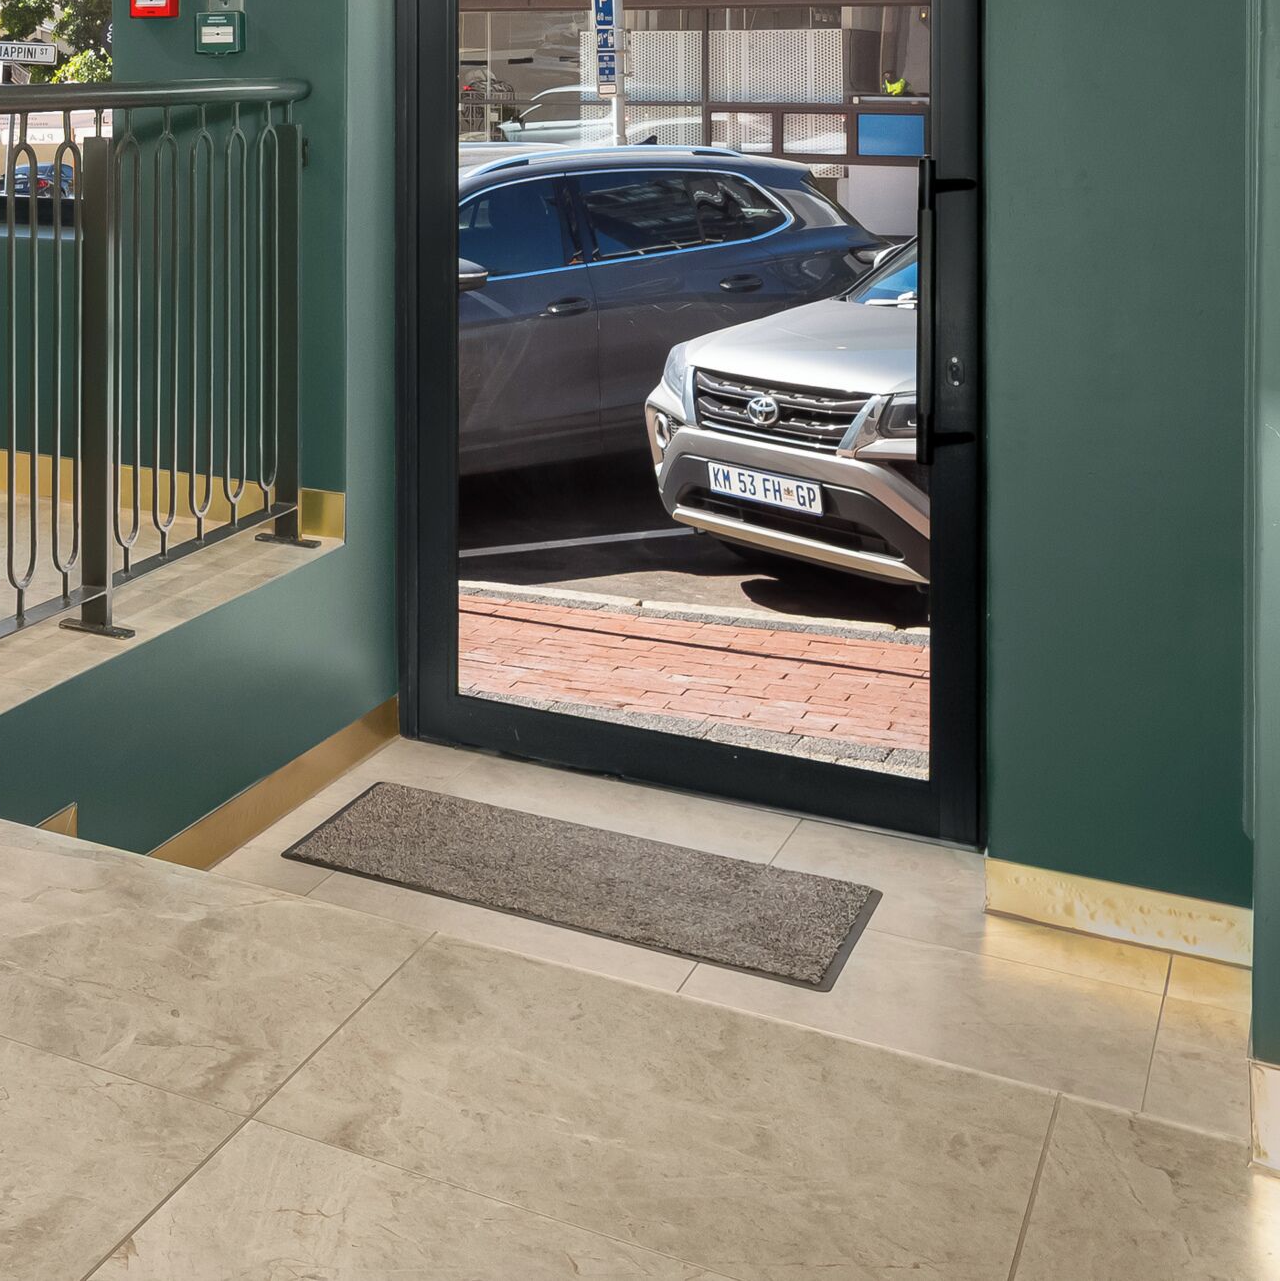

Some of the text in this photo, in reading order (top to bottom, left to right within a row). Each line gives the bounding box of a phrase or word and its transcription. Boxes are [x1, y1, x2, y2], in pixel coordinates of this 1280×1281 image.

[712, 468, 817, 508] KM 53 FH GP
